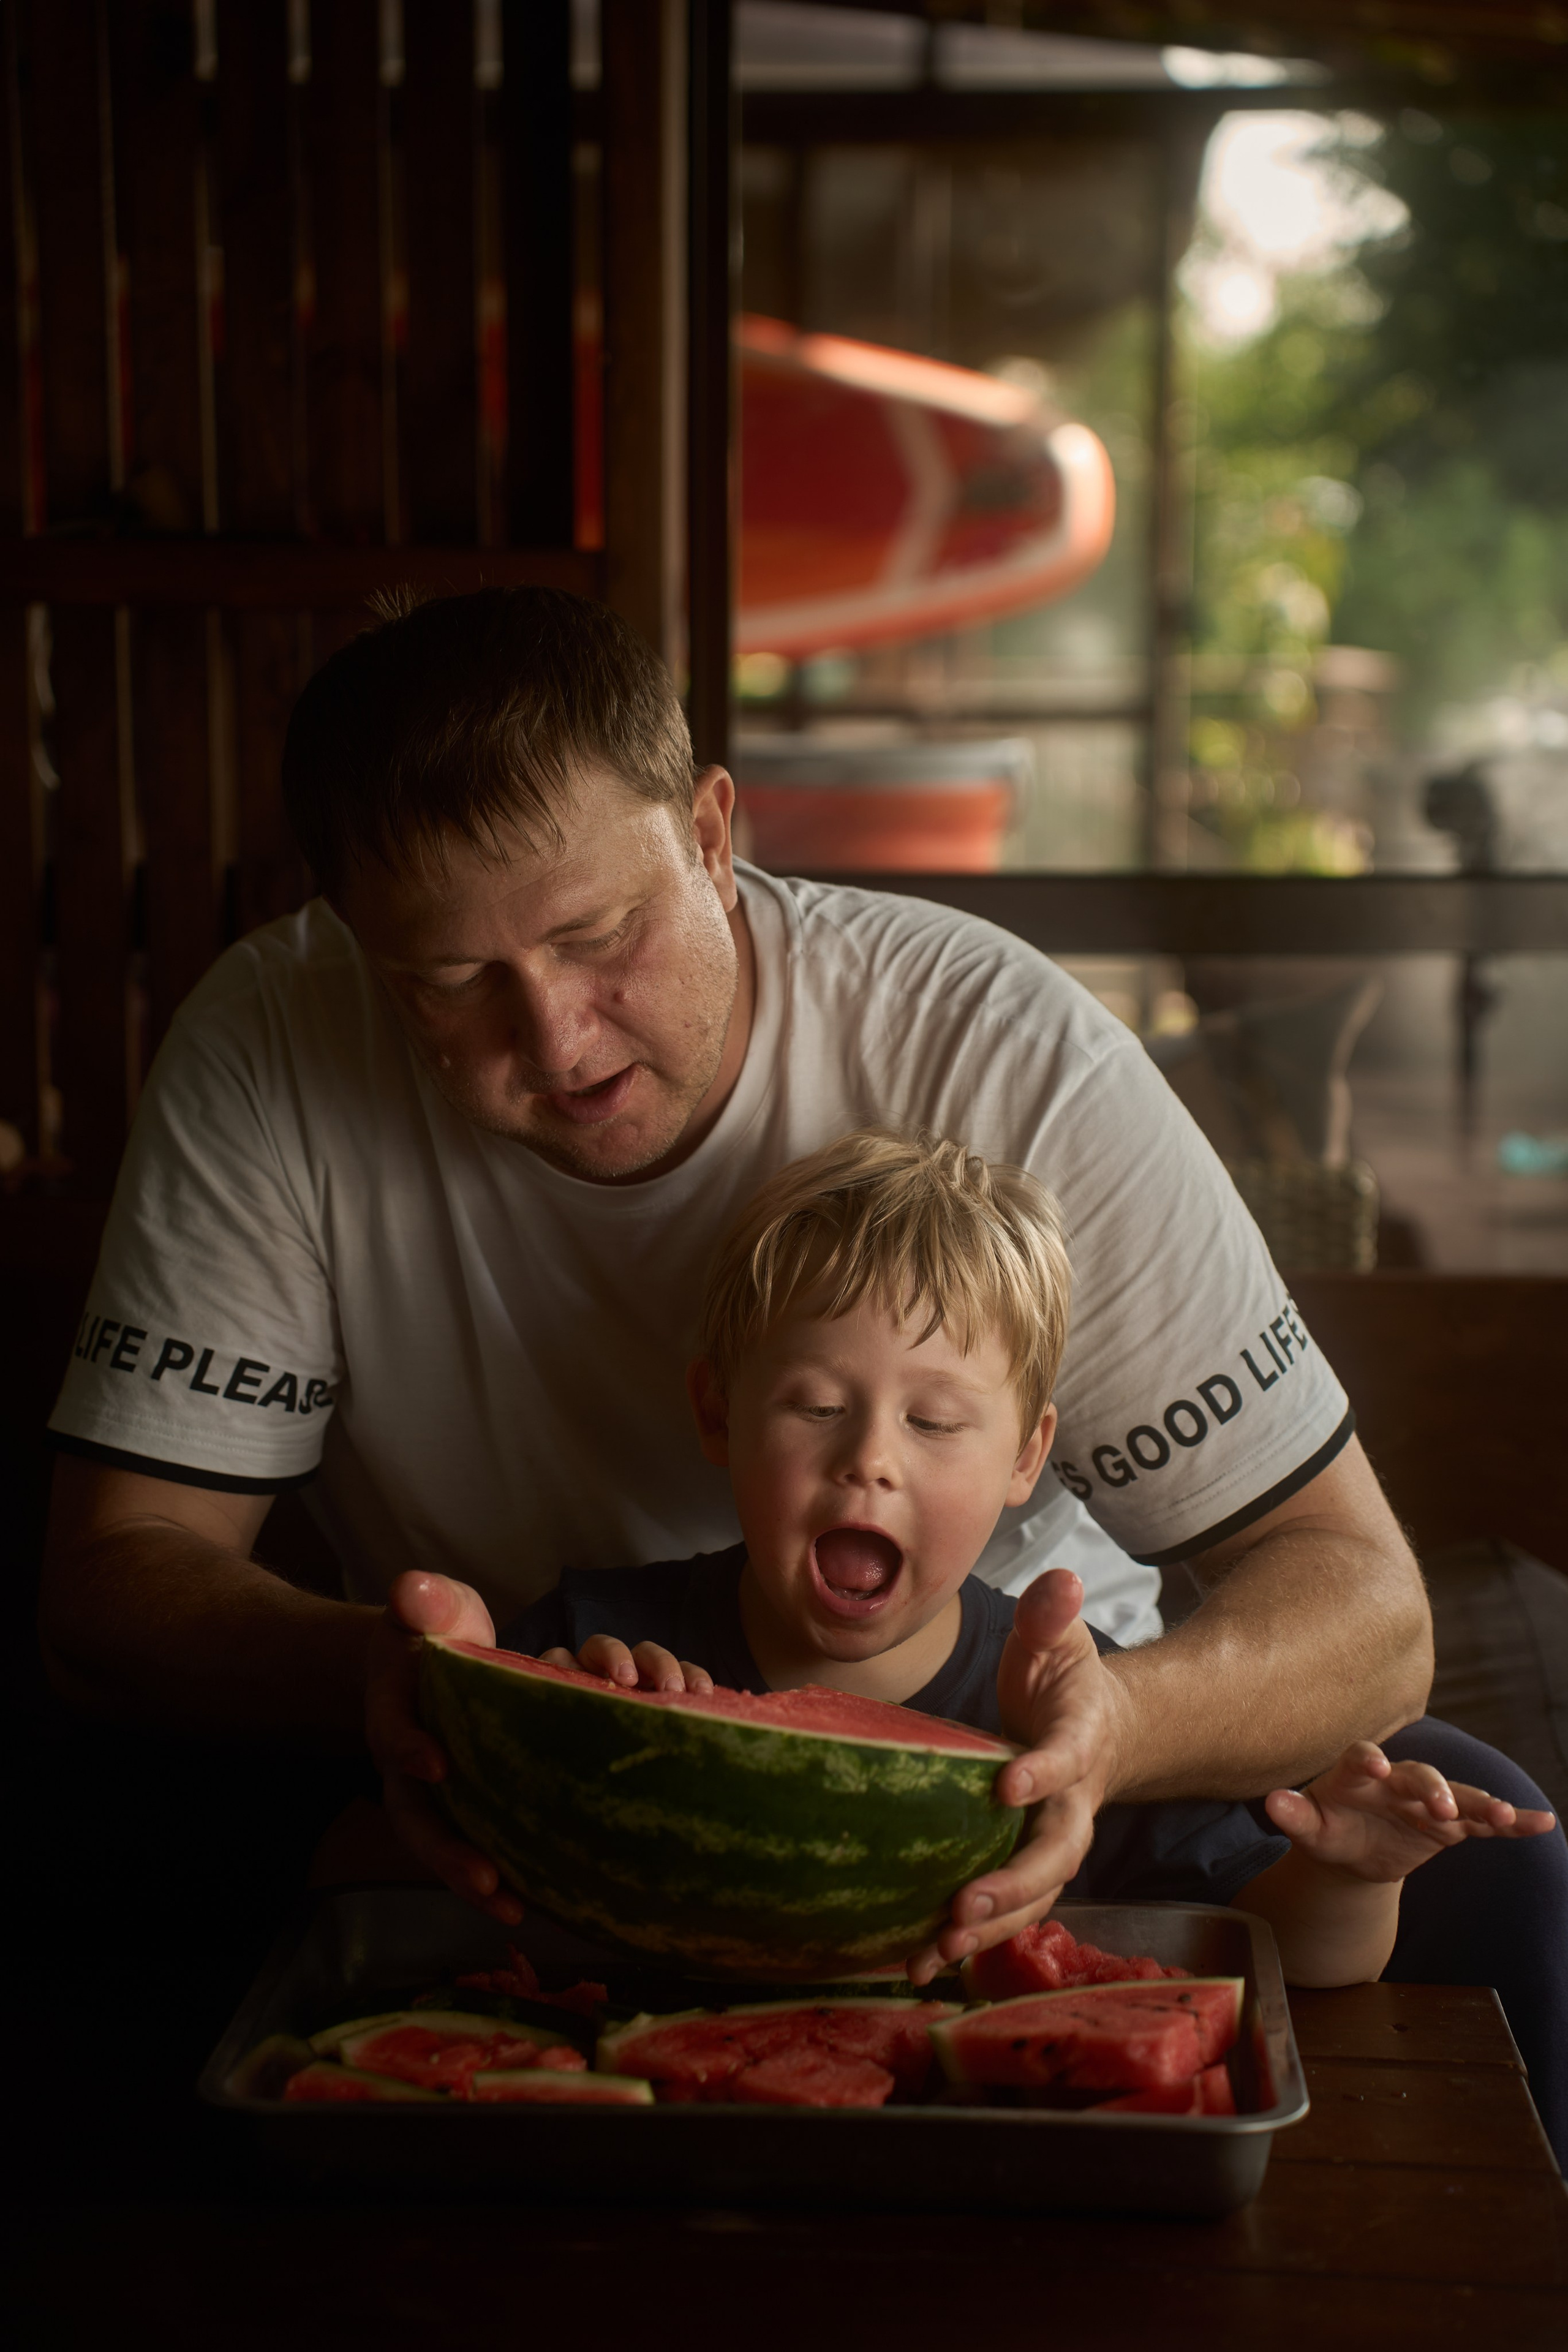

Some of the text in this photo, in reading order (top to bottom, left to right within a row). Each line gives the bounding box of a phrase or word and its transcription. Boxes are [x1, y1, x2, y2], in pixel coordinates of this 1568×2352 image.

[75, 1311, 148, 1373] LIFE
[1091, 1374, 1243, 1488] GOOD
[1240, 1304, 1308, 1392] LIFE
